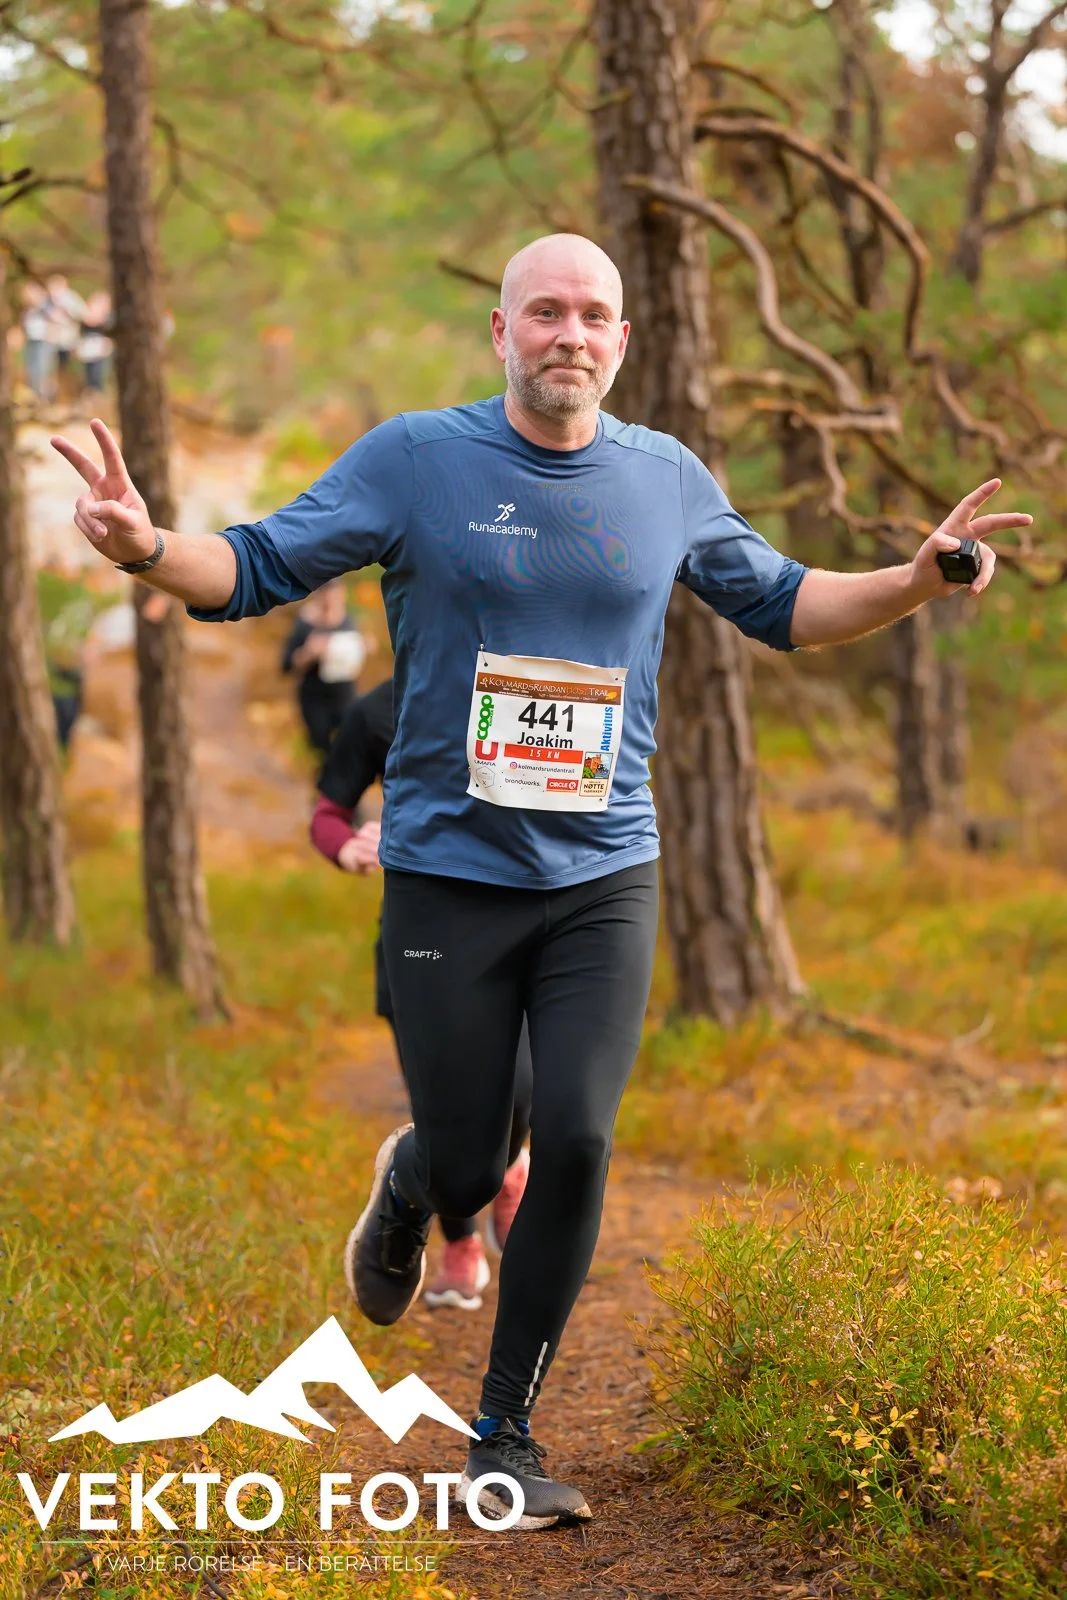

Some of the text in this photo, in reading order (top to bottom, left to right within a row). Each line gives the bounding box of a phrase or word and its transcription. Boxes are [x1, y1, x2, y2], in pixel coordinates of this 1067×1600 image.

[468, 521, 538, 539] Runacademy
[477, 694, 494, 740] coop
[518, 701, 575, 732] 441
[600, 706, 614, 751] Aktivitus
[517, 732, 574, 749] Joakim
[528, 749, 561, 759] 15 KM
[518, 764, 575, 774] kolmardsrundantrail
[549, 781, 568, 789] CIRCLE
[403, 950, 432, 958] CRAFT
